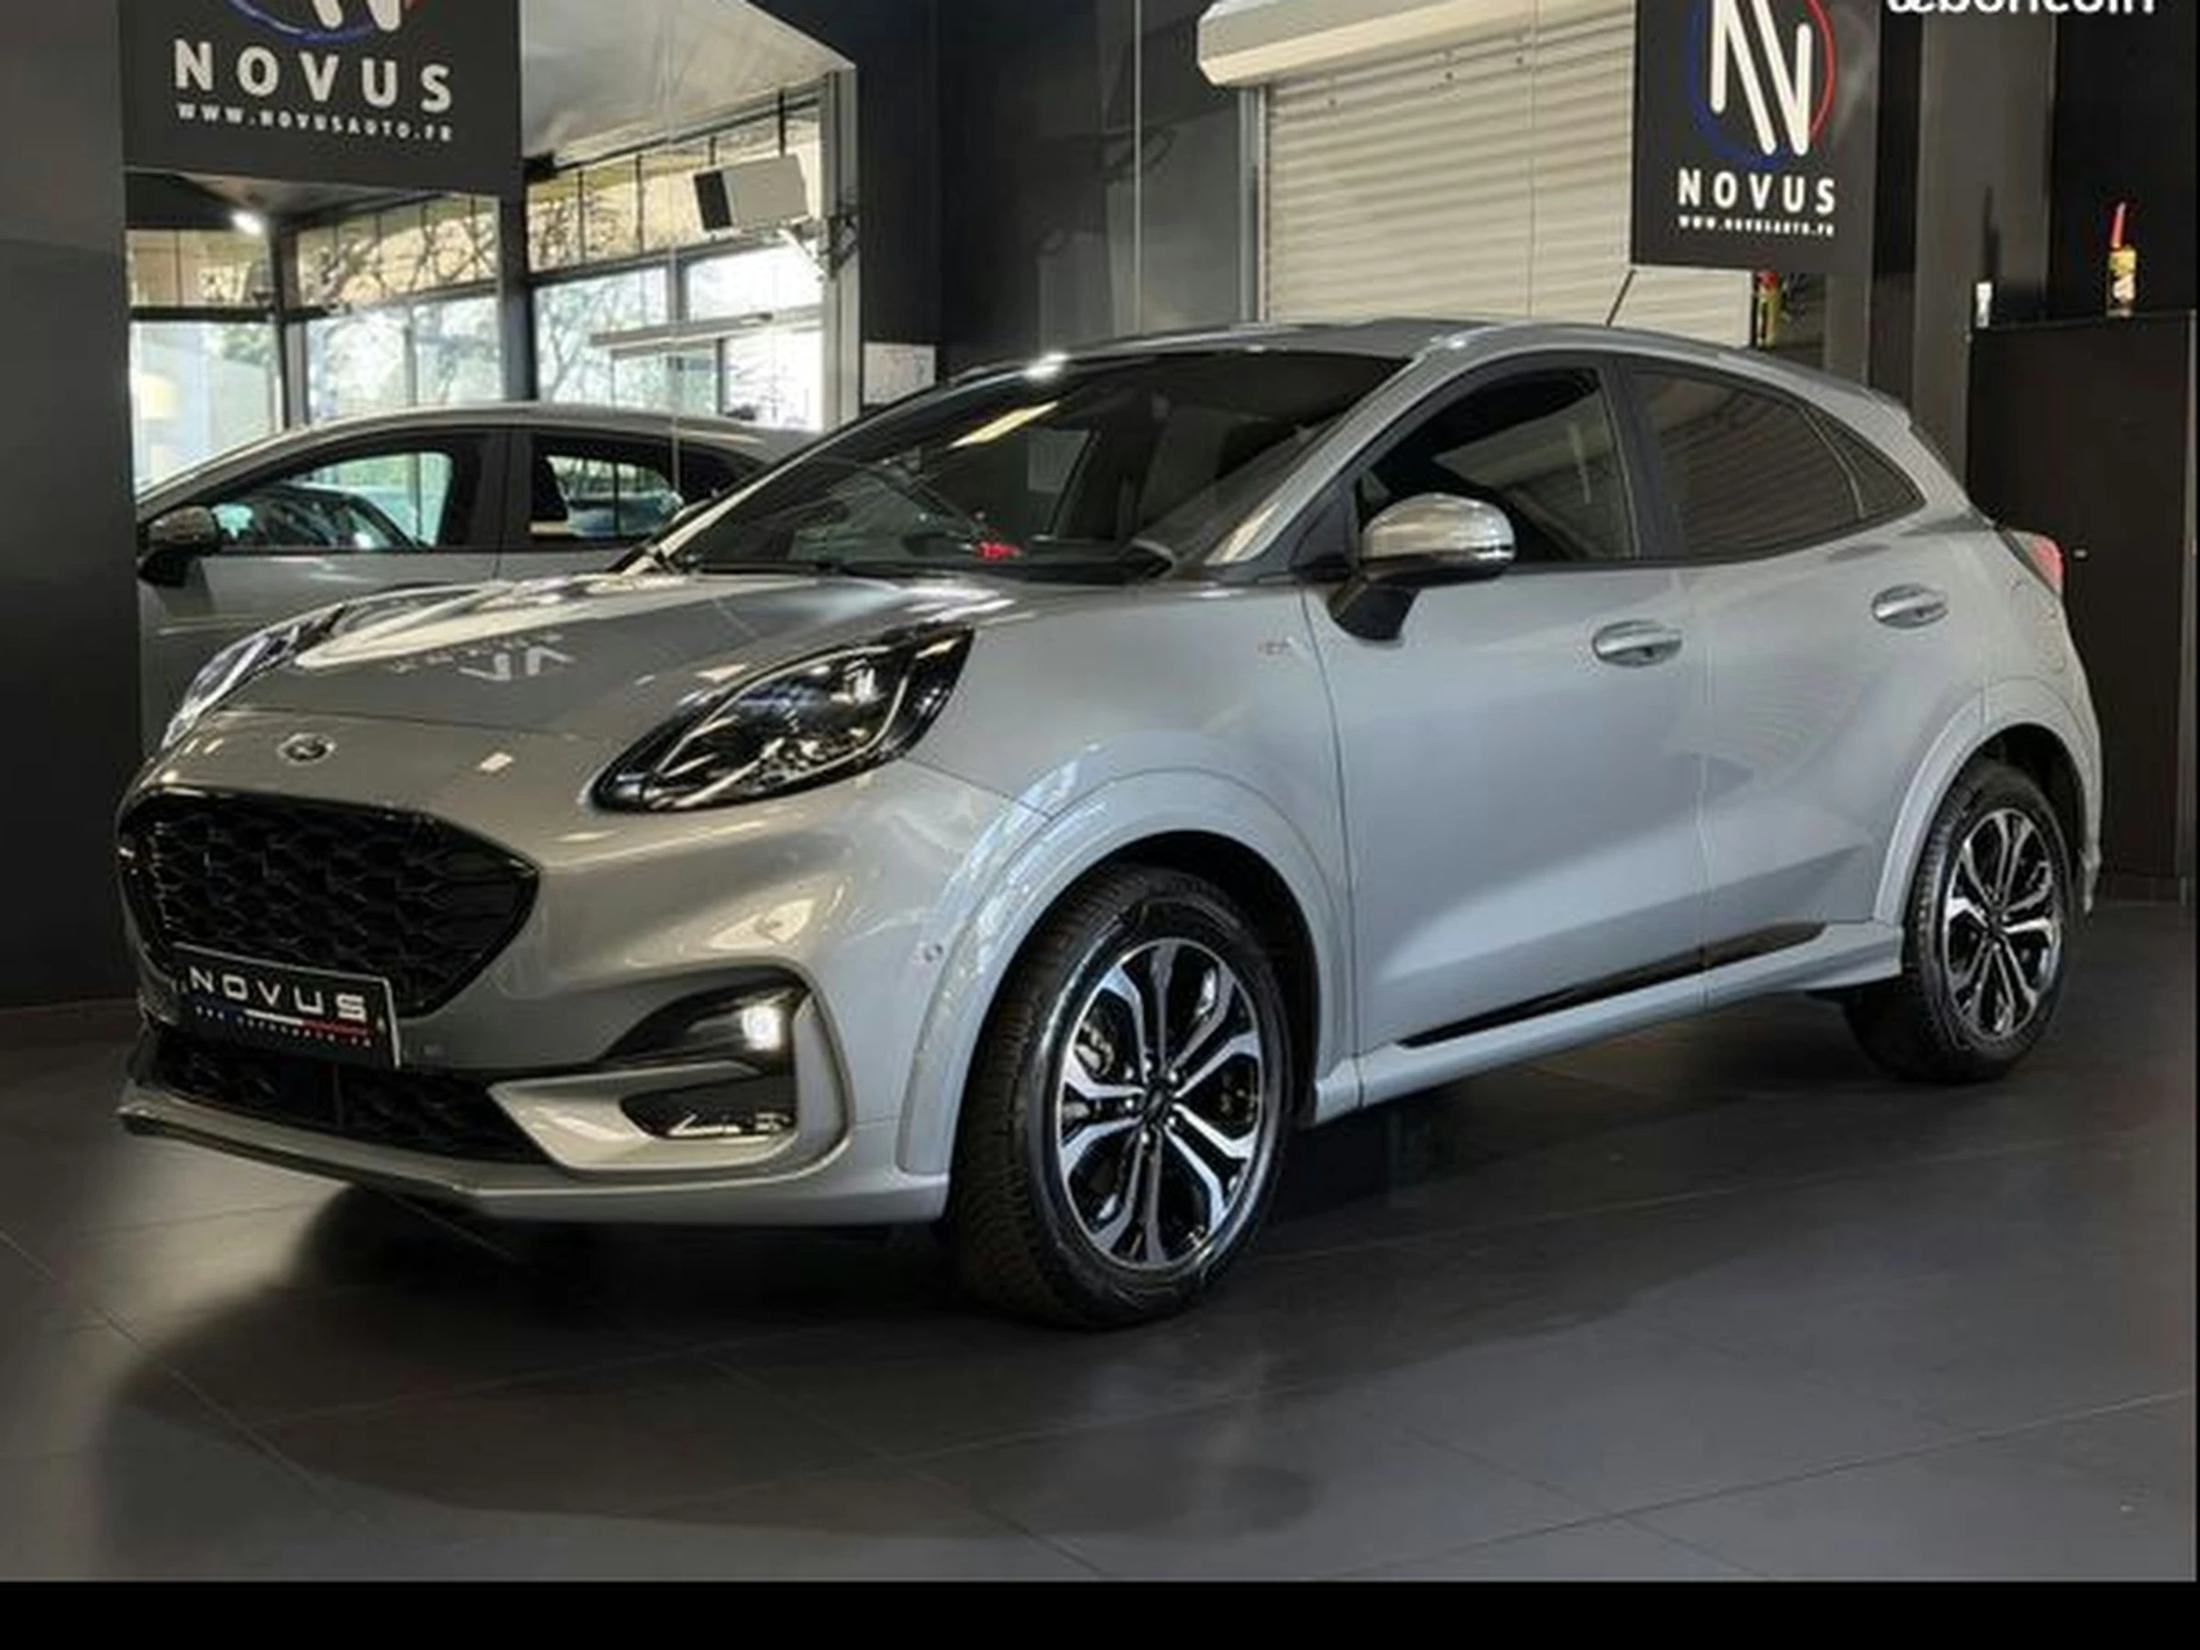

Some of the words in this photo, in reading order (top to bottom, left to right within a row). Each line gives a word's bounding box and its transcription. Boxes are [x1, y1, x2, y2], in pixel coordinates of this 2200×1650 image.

[174, 38, 452, 114] NOVUS
[177, 103, 453, 142] WWW.NOVUSAUTO.FR
[1677, 167, 1836, 215] NOVUS
[189, 966, 367, 1022] NOVUS
